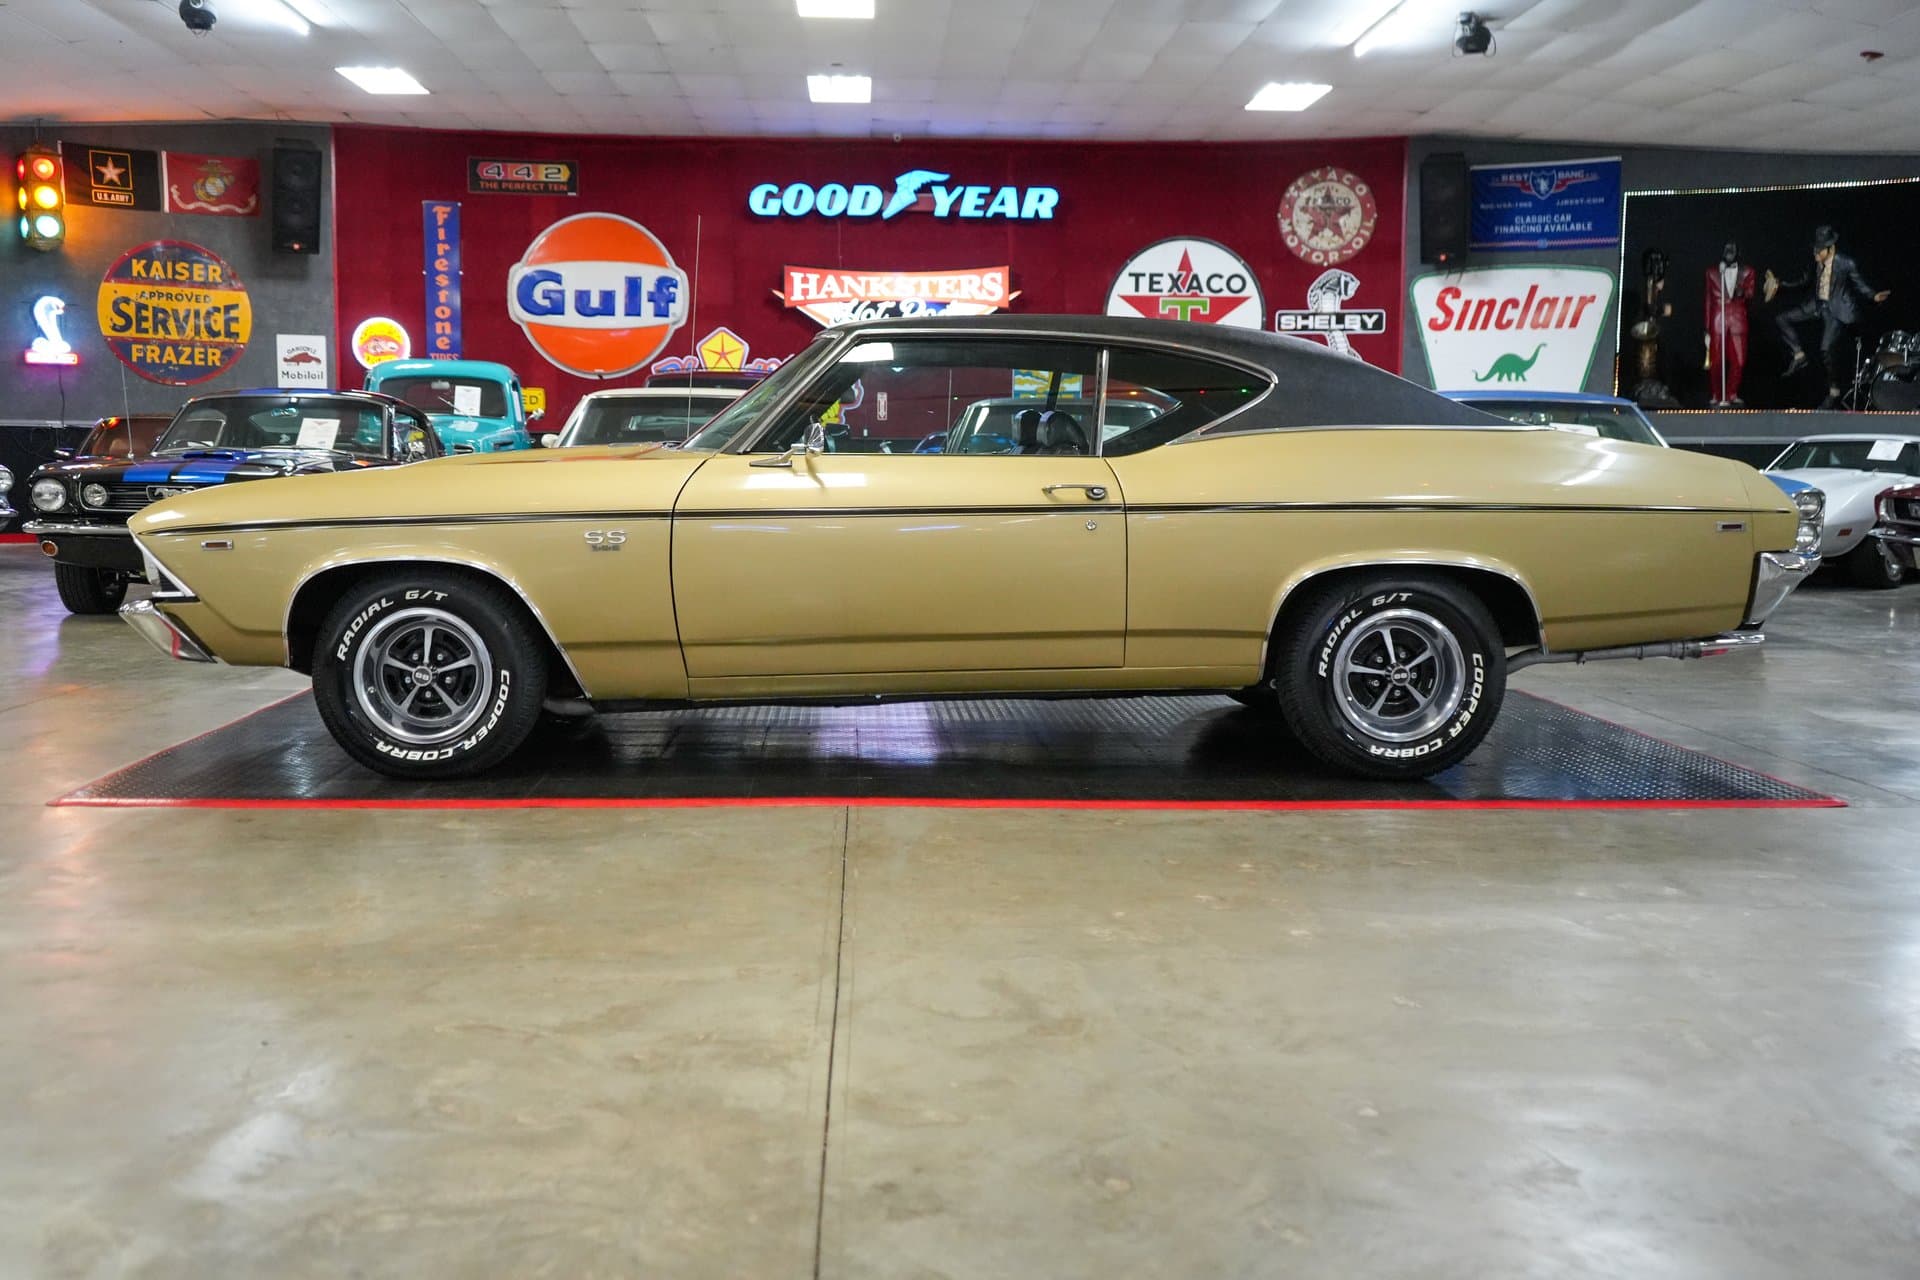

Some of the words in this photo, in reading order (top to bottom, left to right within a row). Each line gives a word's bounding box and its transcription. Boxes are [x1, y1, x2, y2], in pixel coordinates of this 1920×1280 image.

[480, 181, 499, 190] THE
[502, 182, 545, 191] PERFECT
[548, 183, 568, 191] TEN
[110, 193, 129, 203] ARMY
[1494, 224, 1542, 234] FINANCING
[1544, 221, 1593, 233] AVAILABLE
[1514, 214, 1551, 225] CLASSIC
[1553, 213, 1572, 223] CAR
[131, 258, 223, 283] KAISER
[432, 205, 452, 350] Firestone
[516, 269, 678, 318] Gulf
[790, 271, 1004, 302] HANKSTERS
[1129, 272, 1247, 295] TEXACO
[138, 290, 213, 304] APPROVED
[1428, 284, 1597, 331] Sinclair
[111, 296, 240, 340] SERVICE
[1280, 314, 1378, 331] SHELBY
[131, 343, 222, 367] FRAZER
[281, 371, 324, 380] Mobiloil
[584, 530, 626, 544] SS
[337, 597, 394, 661] RADIAL
[405, 589, 448, 602] G/T
[1318, 609, 1363, 678] RADIAL
[1372, 592, 1413, 607] G/T
[1449, 653, 1485, 739] COOPER
[463, 669, 510, 751] COOPER
[375, 740, 454, 762] COBRA
[1369, 737, 1445, 759] COBRA
